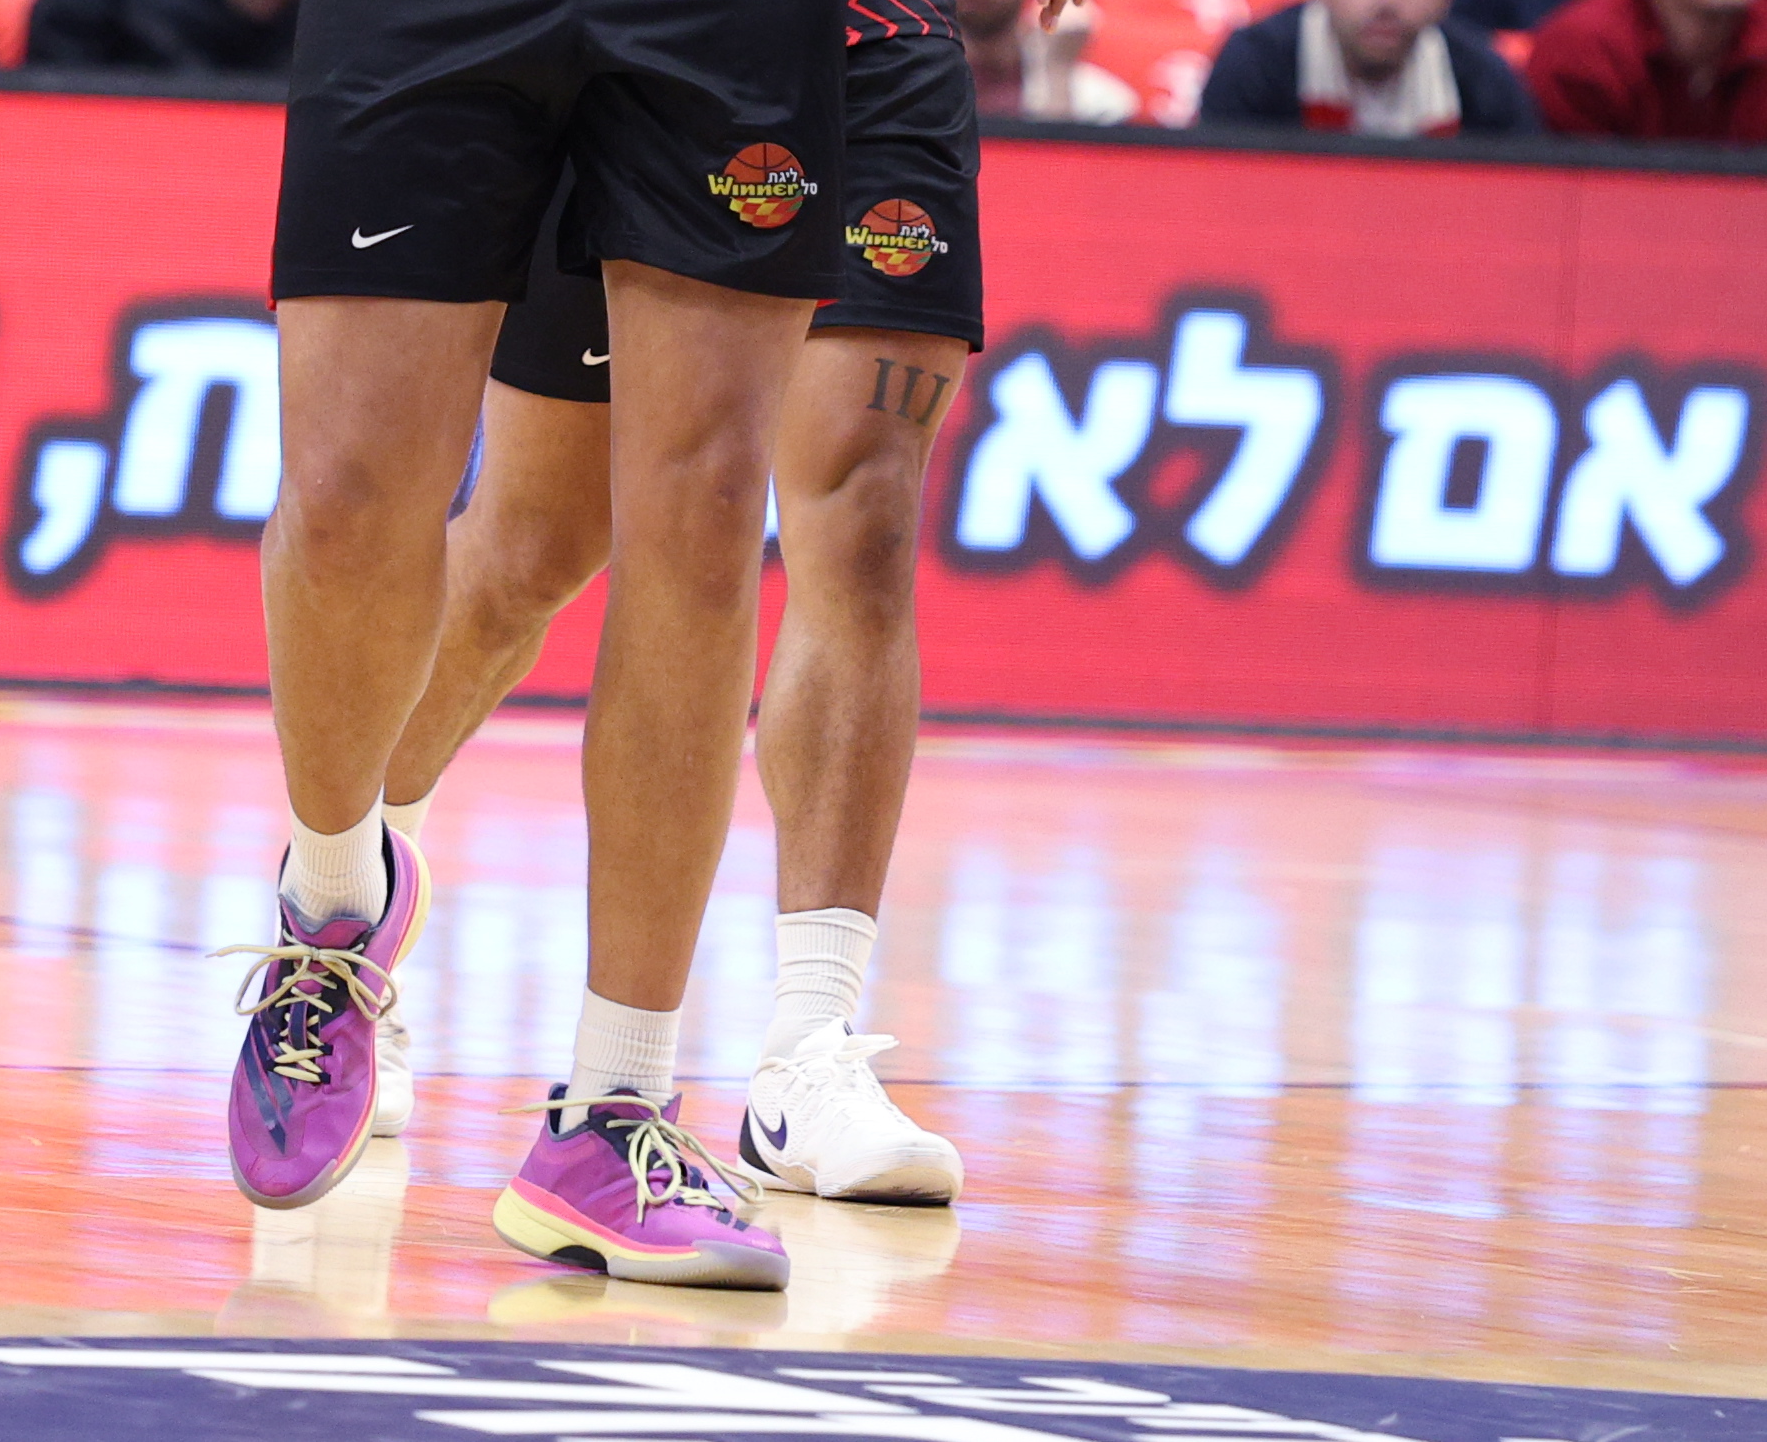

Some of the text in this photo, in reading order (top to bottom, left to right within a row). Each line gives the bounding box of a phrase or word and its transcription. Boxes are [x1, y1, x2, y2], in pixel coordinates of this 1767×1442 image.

[707, 173, 801, 197] Winner
[766, 167, 799, 184] ליגת
[800, 178, 819, 195] סל
[845, 225, 931, 250] Winner
[899, 224, 931, 239] ליגת
[930, 236, 949, 254] סל
[955, 306, 1324, 566] לא
[1369, 374, 1750, 586] אם
